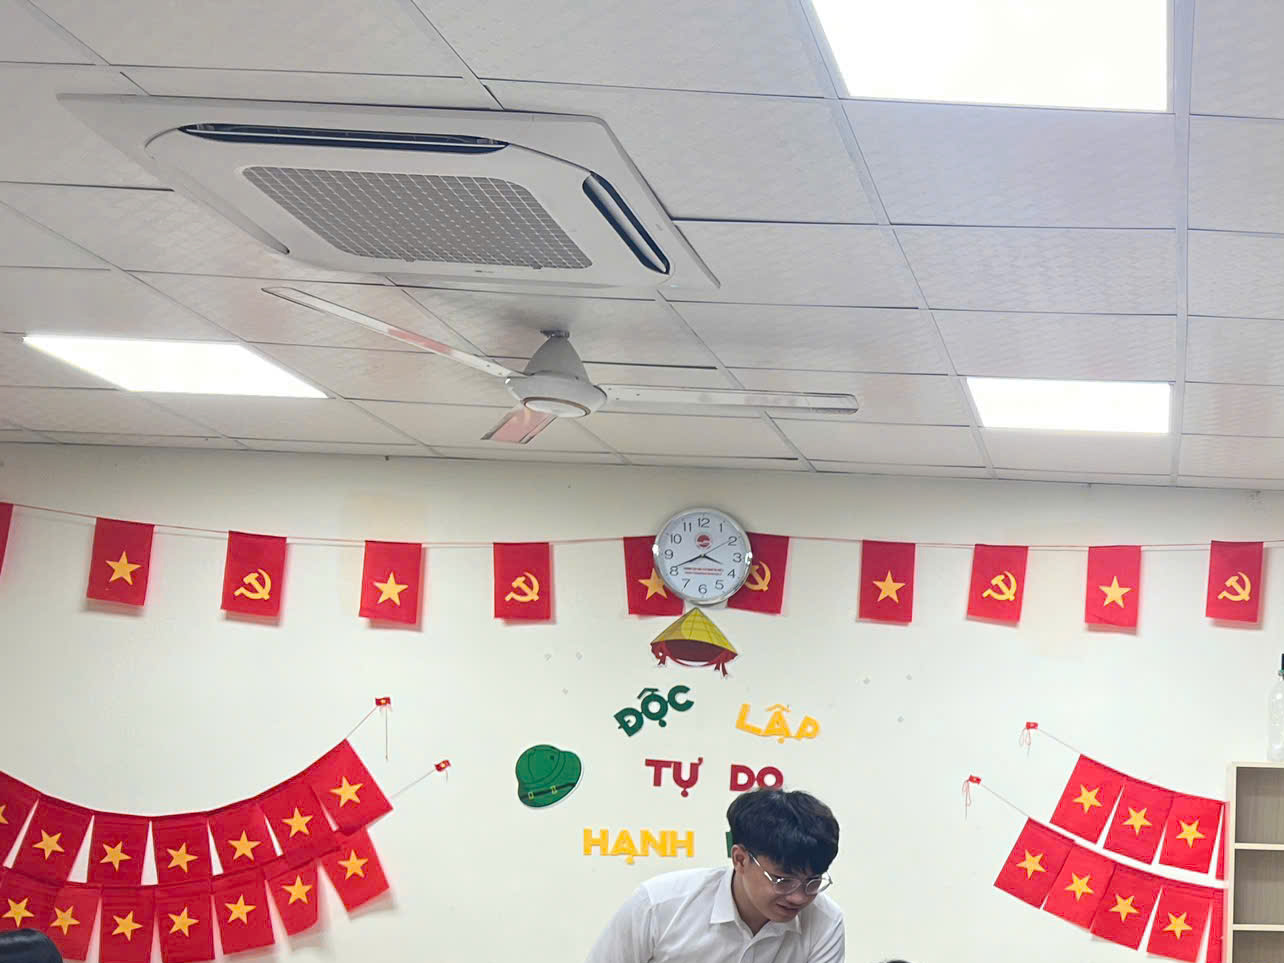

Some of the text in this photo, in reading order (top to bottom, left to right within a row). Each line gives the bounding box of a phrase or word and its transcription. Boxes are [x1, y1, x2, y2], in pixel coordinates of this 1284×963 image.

[683, 521, 692, 532] 11
[698, 517, 711, 528] 12
[670, 533, 682, 544] 10
[727, 535, 738, 546] 2
[664, 549, 674, 560] 9
[732, 552, 742, 563] 3
[669, 565, 679, 576] 8
[727, 568, 736, 578] 4
[682, 578, 691, 589] 7
[698, 584, 708, 594] 6
[715, 579, 724, 590] 5
[613, 685, 821, 744] ĐỘC LẬP
[644, 757, 784, 798] TỰ DO
[583, 829, 696, 865] HẠNH
